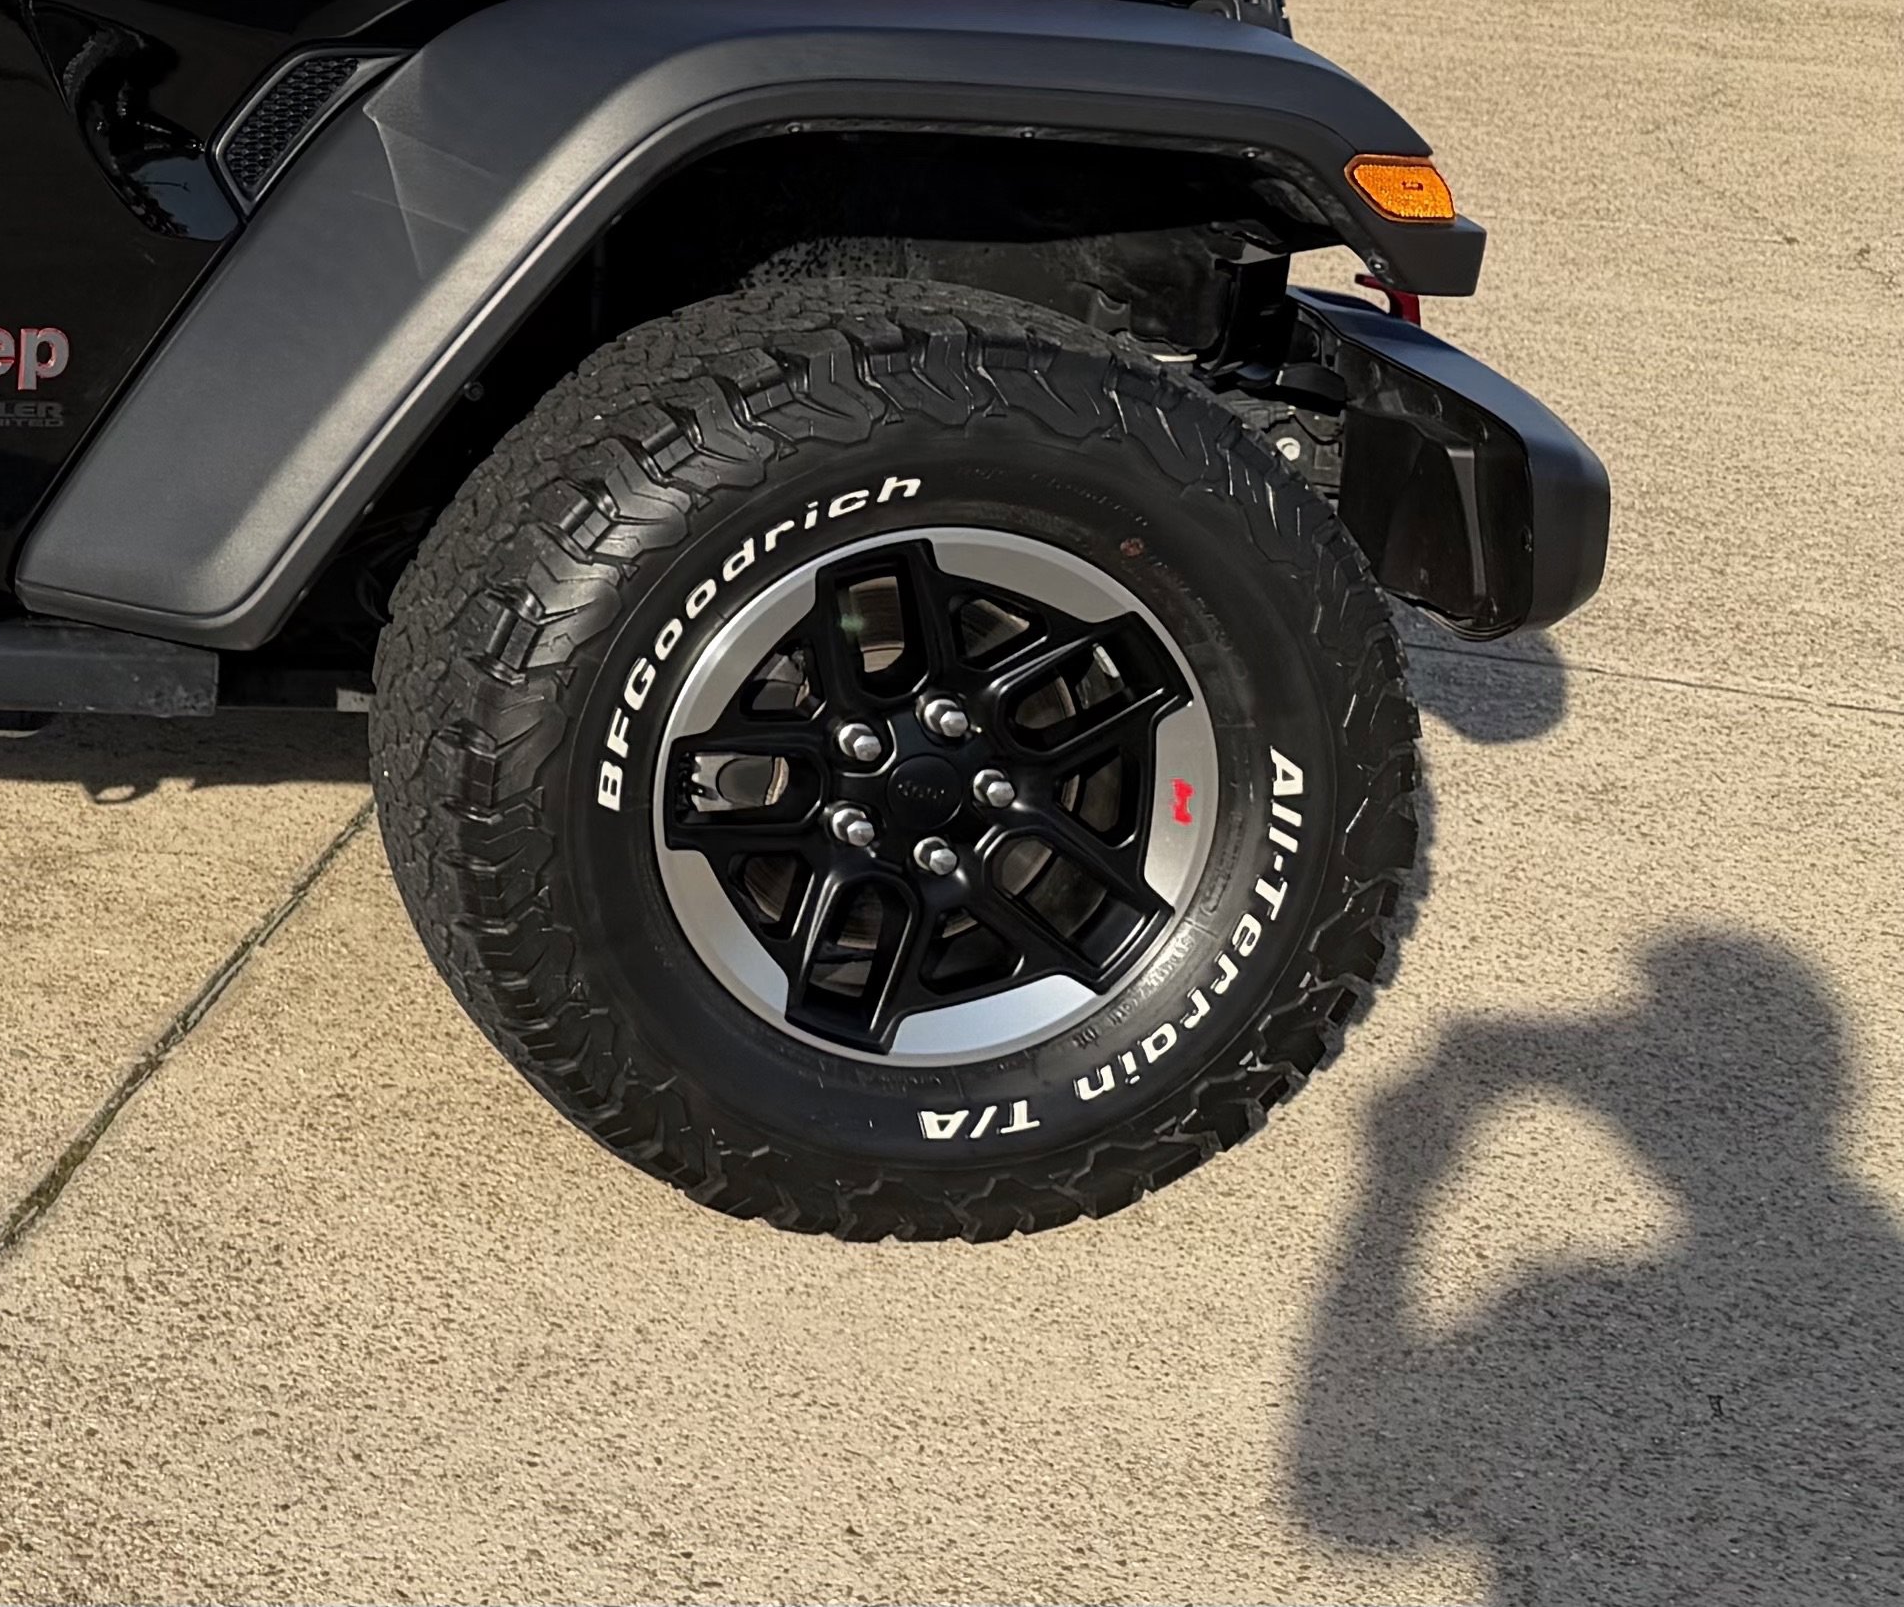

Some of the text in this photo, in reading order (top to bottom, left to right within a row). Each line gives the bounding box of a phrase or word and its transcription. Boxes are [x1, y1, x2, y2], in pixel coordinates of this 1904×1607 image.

[596, 475, 922, 812] BFGoodrich
[1076, 745, 1305, 1102] All-Terrain
[919, 1098, 1041, 1140] T/A
